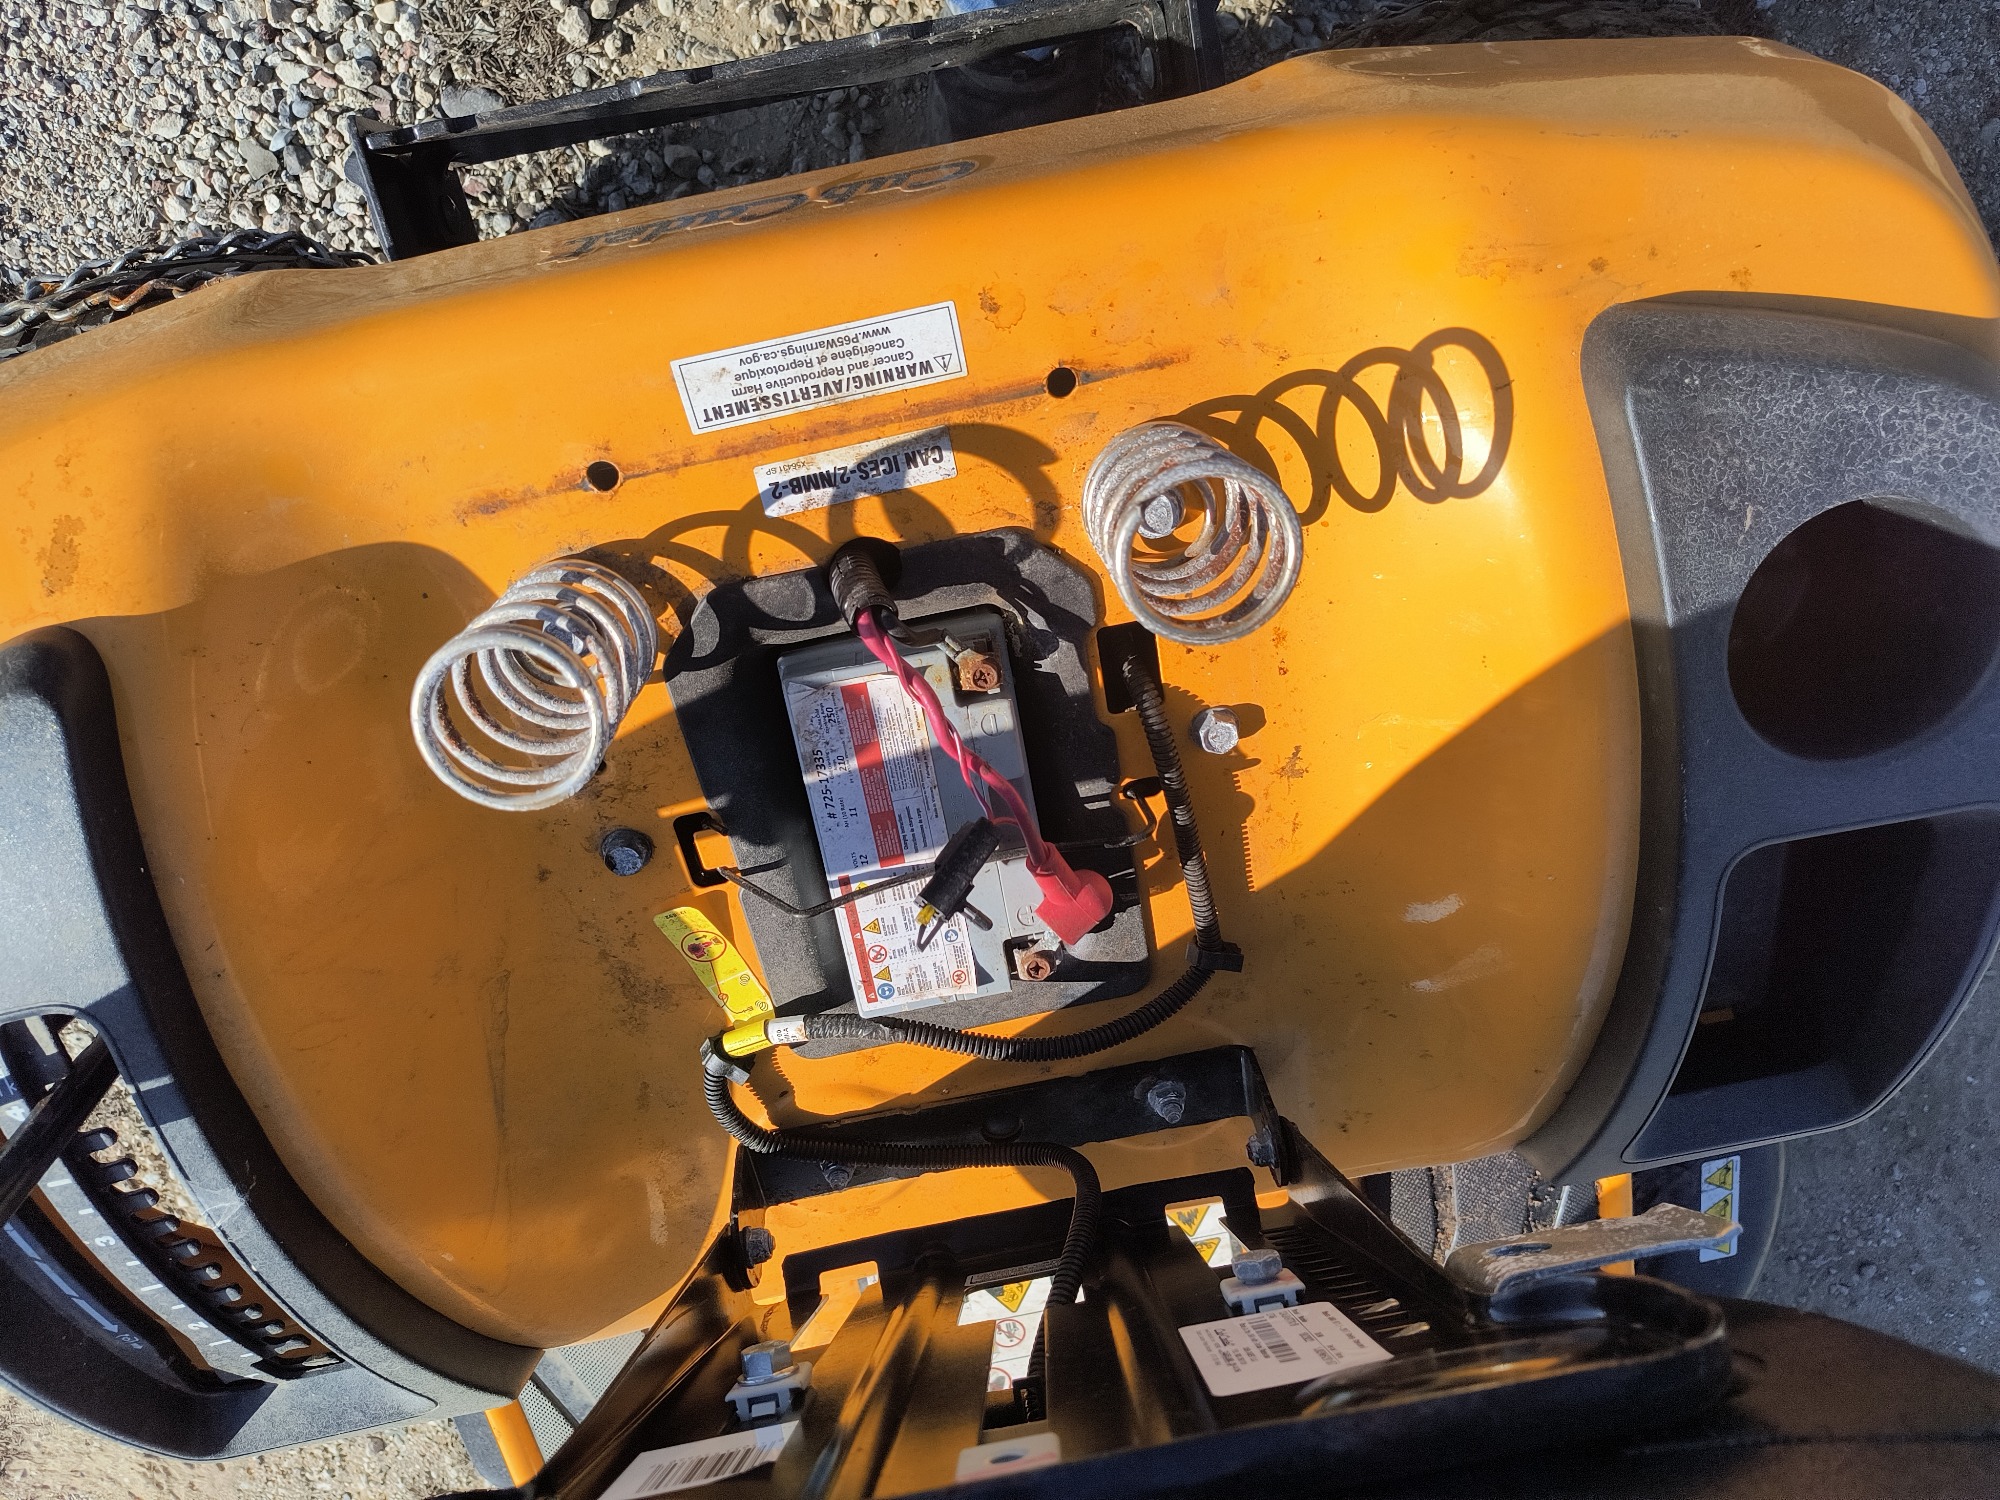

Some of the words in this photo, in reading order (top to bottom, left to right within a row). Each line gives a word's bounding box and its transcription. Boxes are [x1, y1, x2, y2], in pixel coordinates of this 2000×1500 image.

[820, 159, 978, 206] Cub
[737, 324, 891, 366] www.P65Warnings.ca.gov
[829, 337, 905, 363] Cancérigène
[815, 354, 828, 364] et
[846, 359, 870, 374] and
[871, 349, 914, 367] Cancer
[733, 357, 814, 383] Reprotoxique
[764, 364, 844, 392] Reproductive
[700, 359, 934, 422] WARNING/AVERTISSEMENT
[731, 382, 763, 398] Harm
[903, 444, 944, 470] CAN
[764, 466, 777, 475] SP
[767, 454, 900, 500] ICES-2/NMB-2
[825, 706, 836, 724] 250
[836, 754, 847, 772] 210
[811, 748, 835, 809] 725-17335
[826, 811, 837, 820] #
[848, 806, 858, 817] 11
[850, 851, 858, 868] VOLTS
[859, 853, 868, 865] 12
[94, 1235, 115, 1247] 3
[187, 1321, 209, 1330] 2
